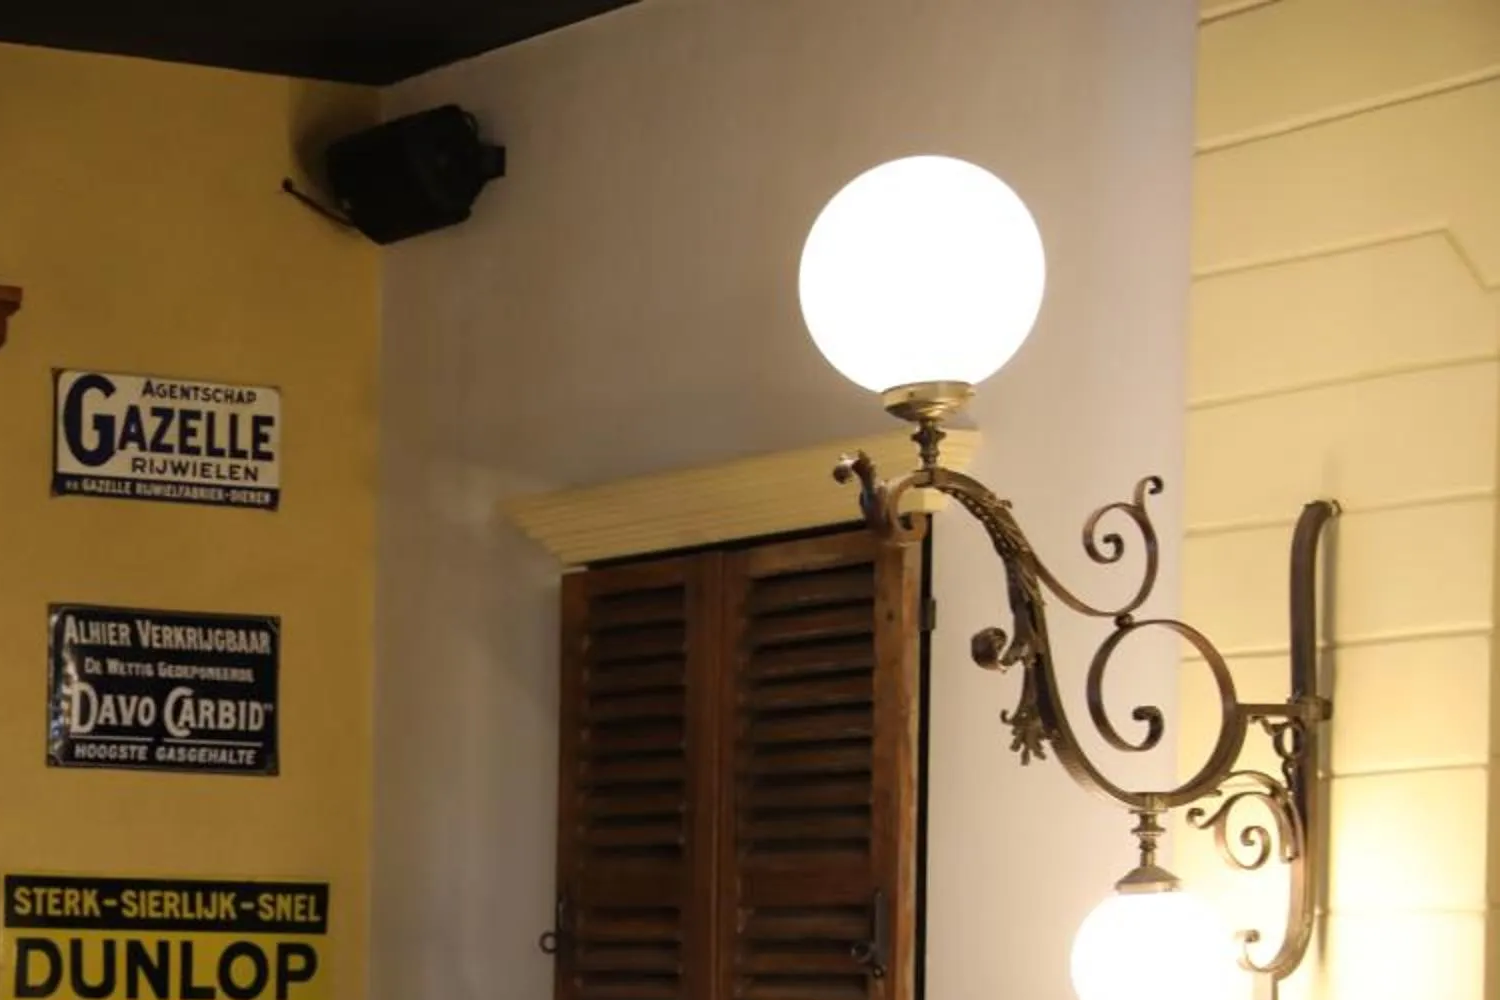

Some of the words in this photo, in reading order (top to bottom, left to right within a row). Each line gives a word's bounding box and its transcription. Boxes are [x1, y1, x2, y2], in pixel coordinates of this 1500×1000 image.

[141, 380, 257, 405] AGENTSCHAP
[63, 373, 275, 467] GAZELLE
[131, 457, 259, 482] RIJWIELEN
[63, 614, 131, 647] ALHIER
[135, 618, 272, 655] VERKRIJGBAAR
[69, 681, 156, 734] DAVO
[74, 743, 149, 762] HOOGSTE
[155, 746, 257, 765] GASGEHALTE
